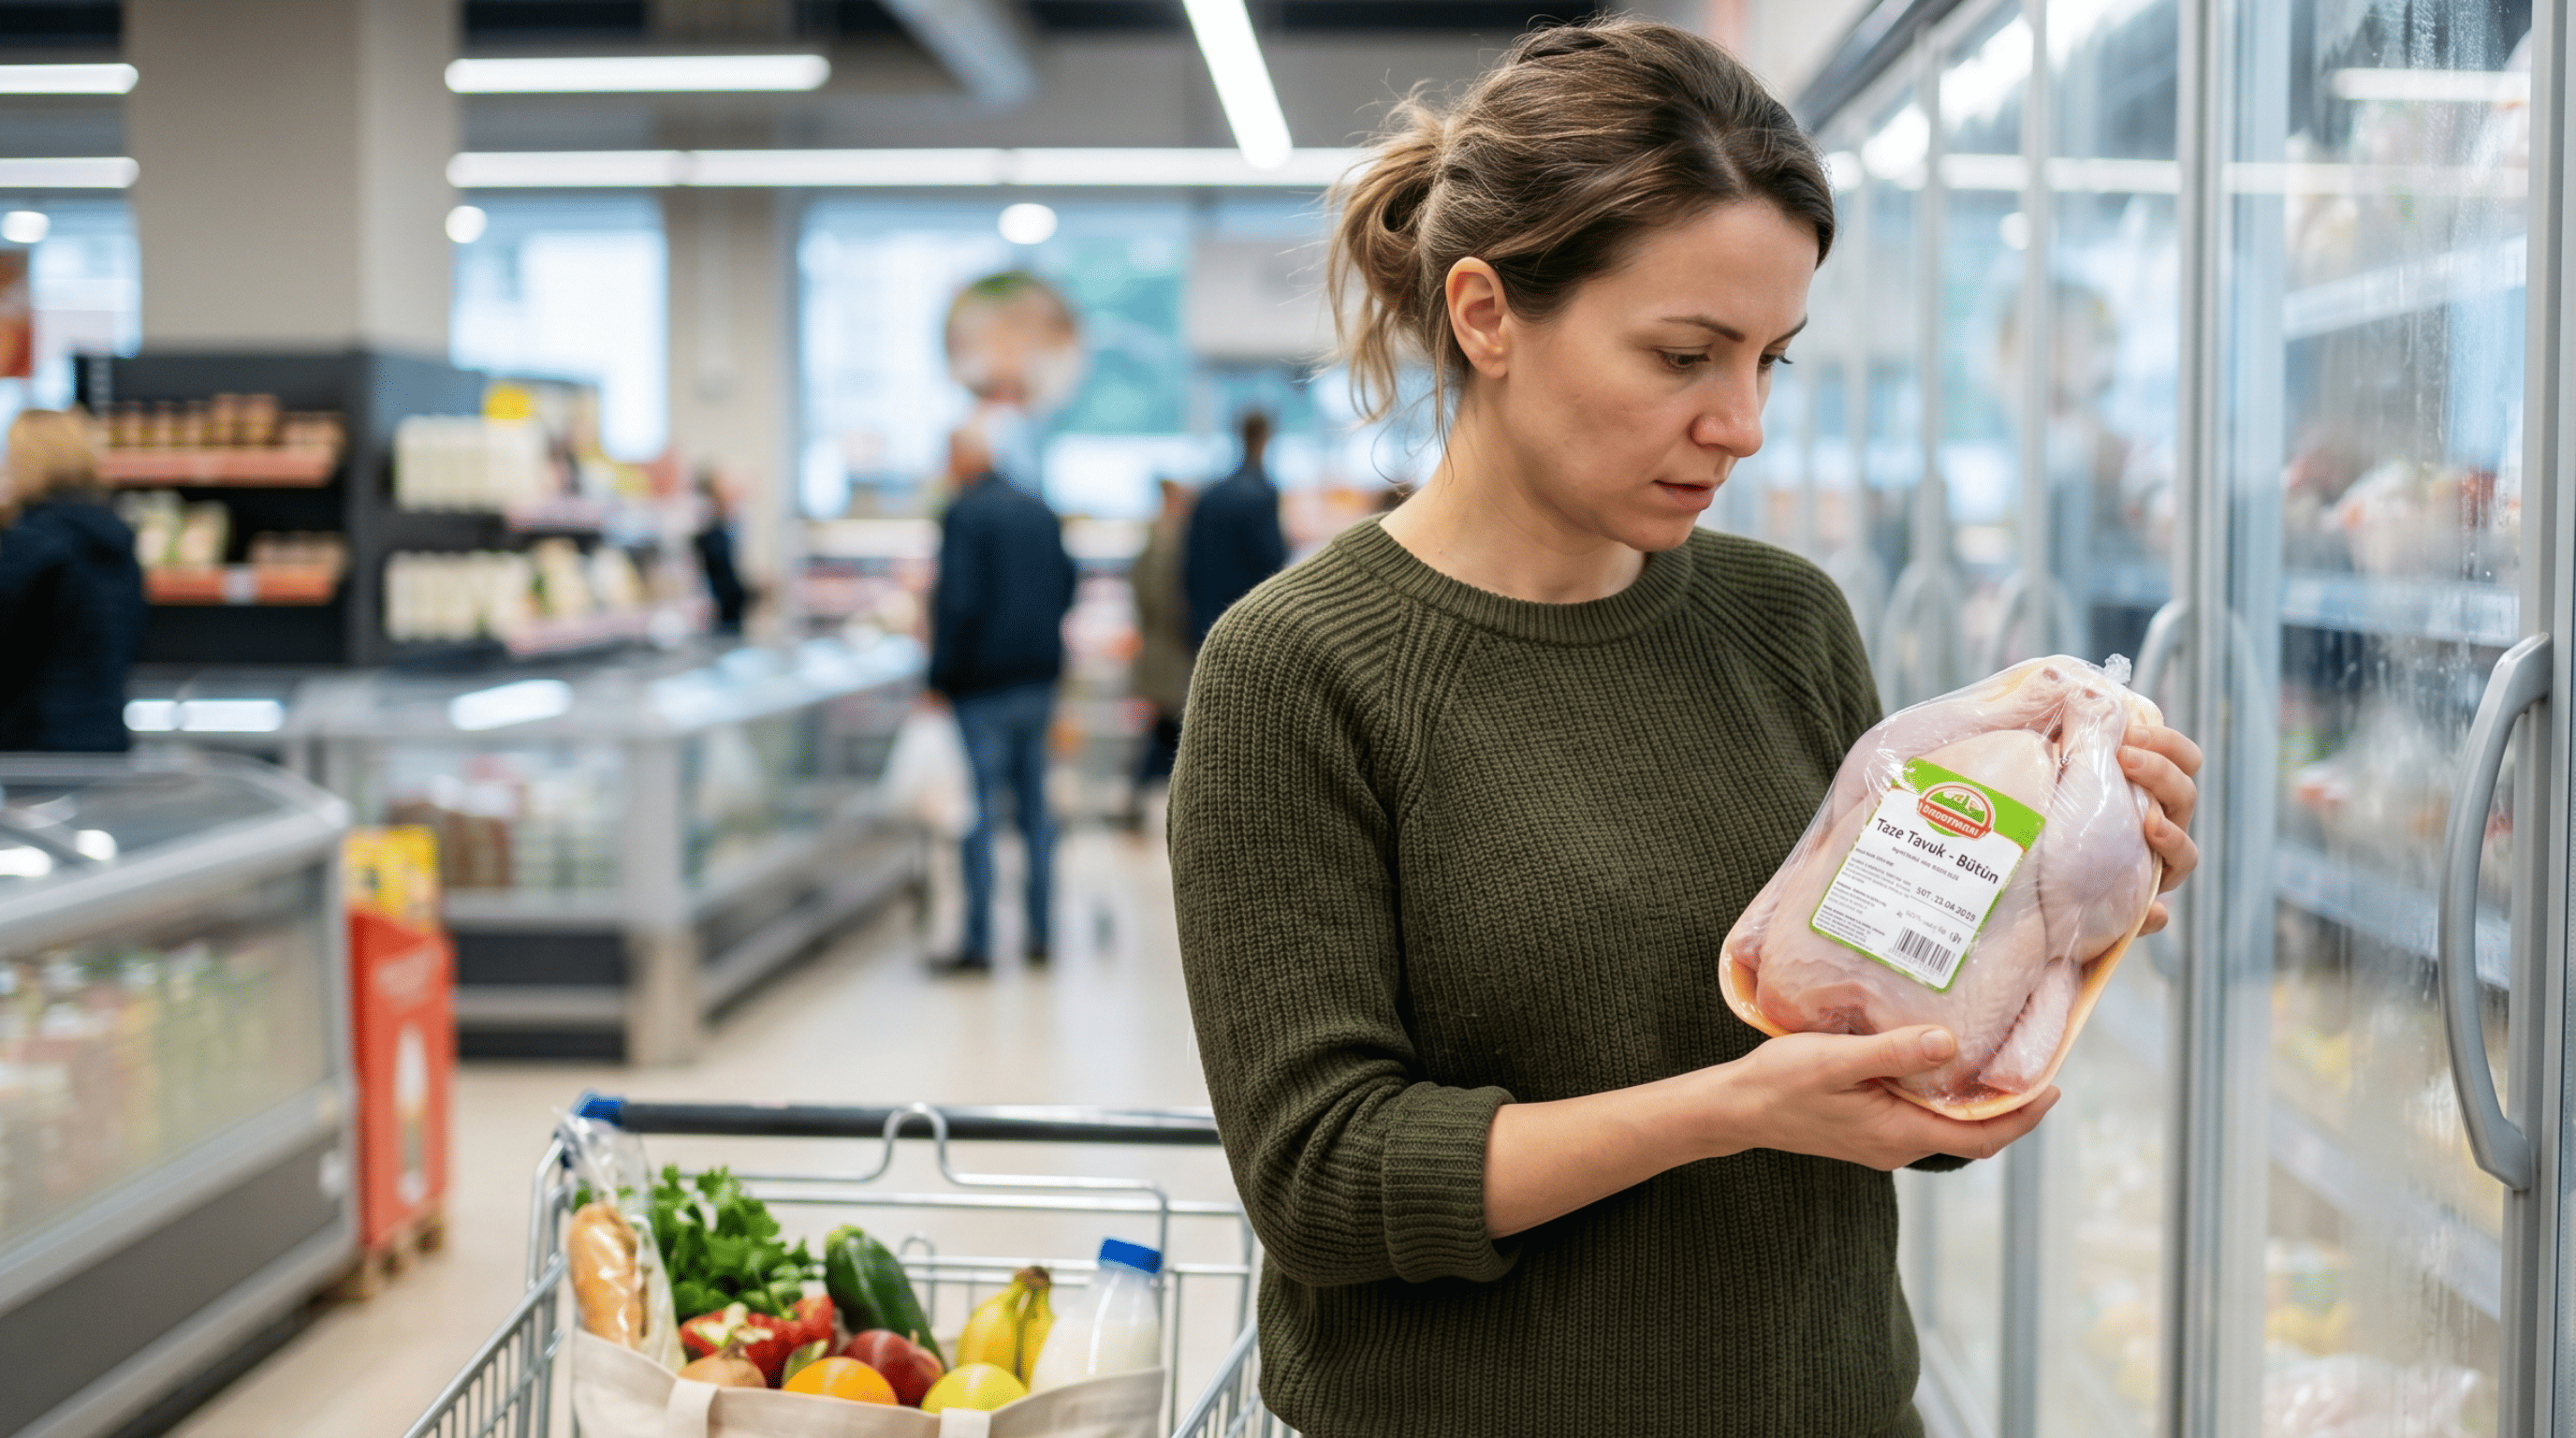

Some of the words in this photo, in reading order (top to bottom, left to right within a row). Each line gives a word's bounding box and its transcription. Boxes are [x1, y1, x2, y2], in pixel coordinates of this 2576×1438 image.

[1876, 817, 1904, 840] Taze
[1908, 829, 1946, 858] Tavuk
[1956, 854, 1998, 885] Bütün
